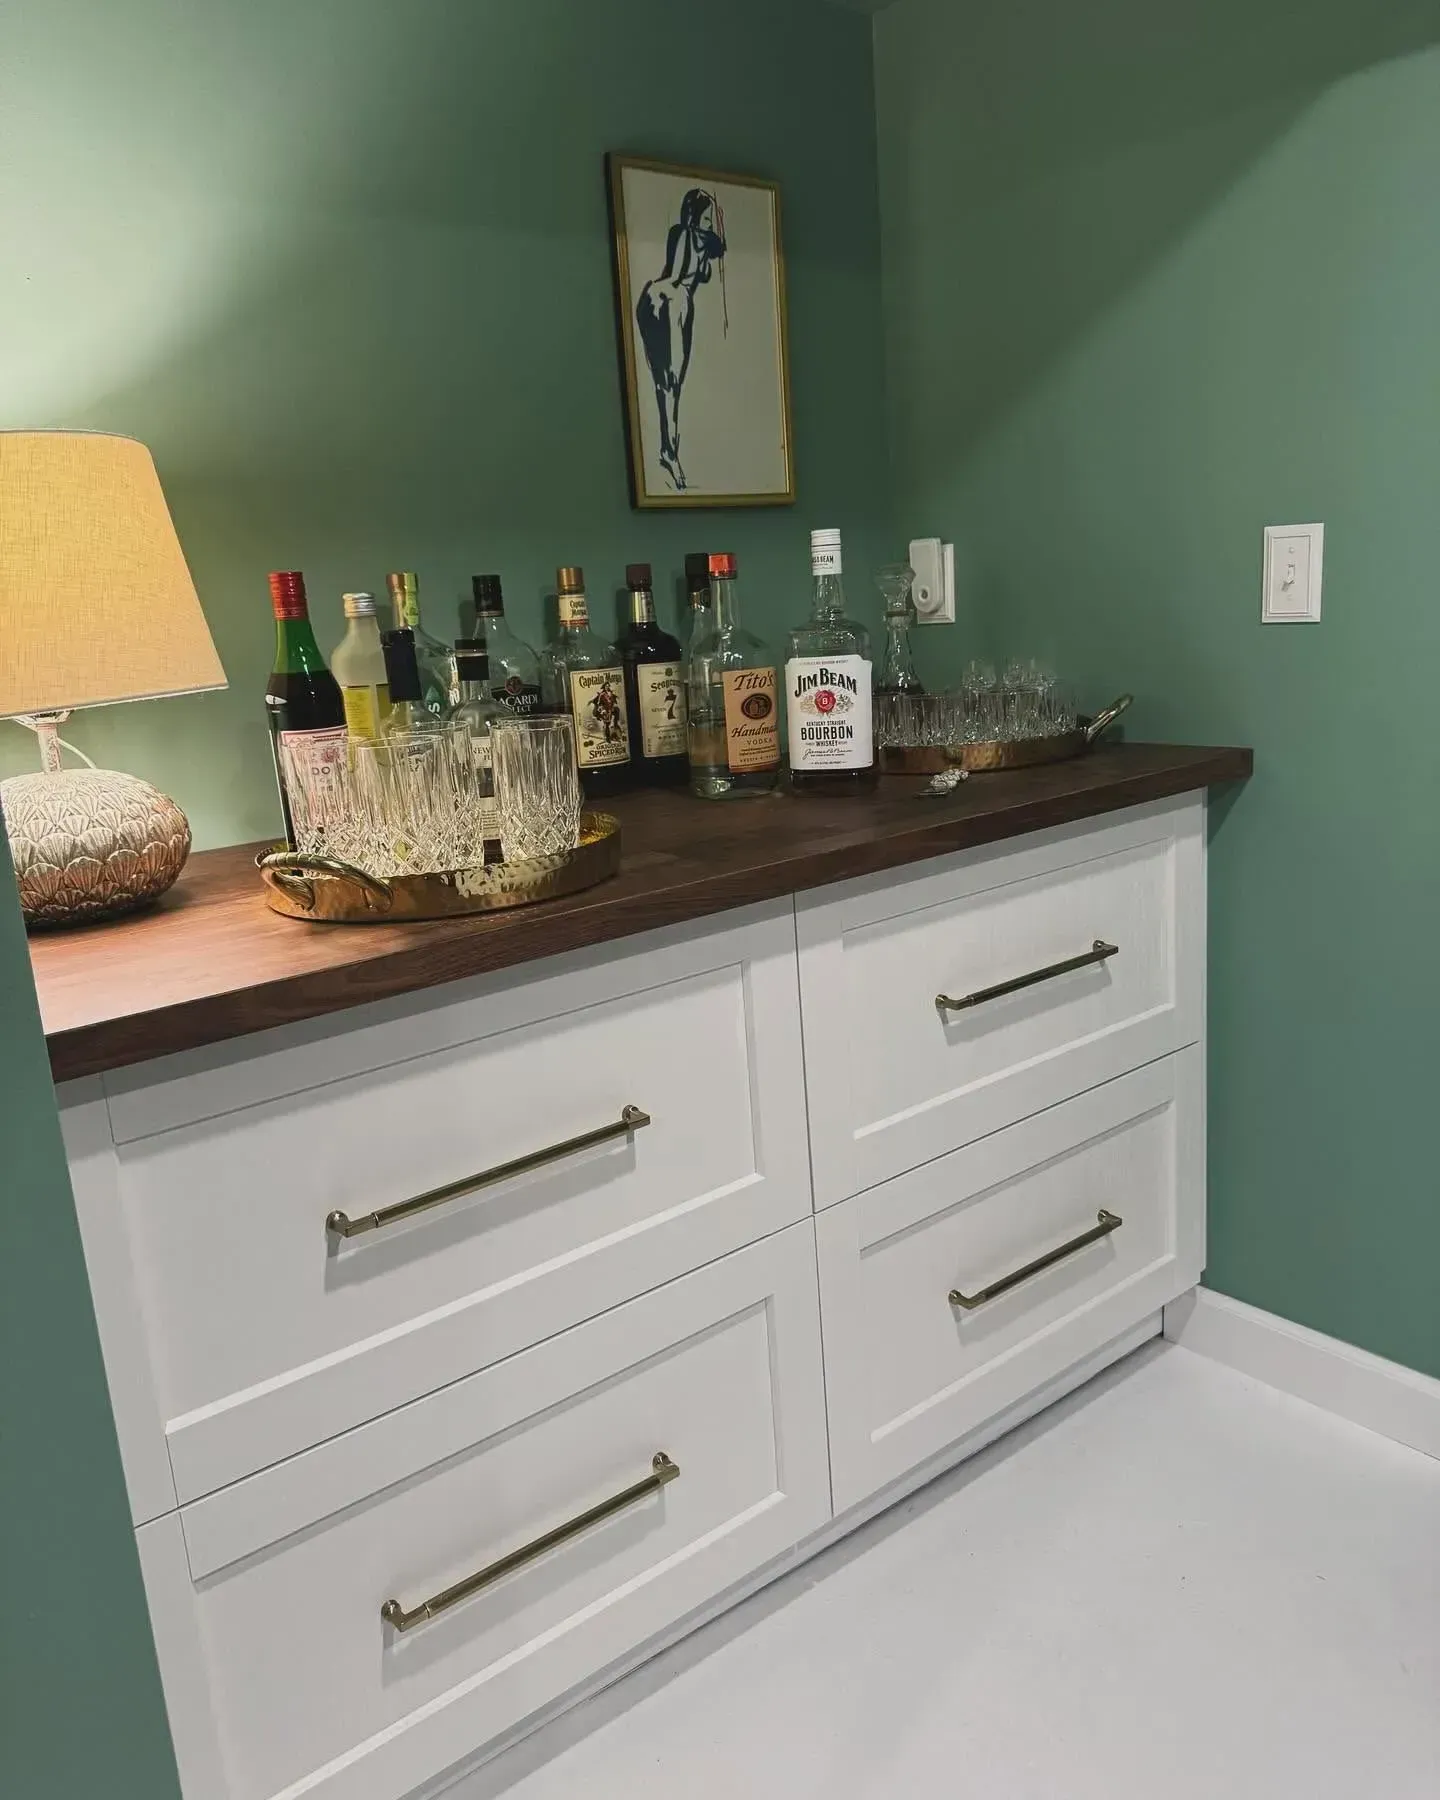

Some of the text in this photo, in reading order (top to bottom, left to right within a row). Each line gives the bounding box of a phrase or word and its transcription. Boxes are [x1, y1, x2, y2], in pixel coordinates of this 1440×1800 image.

[734, 670, 774, 691] Tito's
[794, 668, 858, 698] JIM BEAM
[801, 726, 853, 741] BOURBON
[746, 738, 773, 746] VODKA
[588, 748, 615, 760] SPICED
